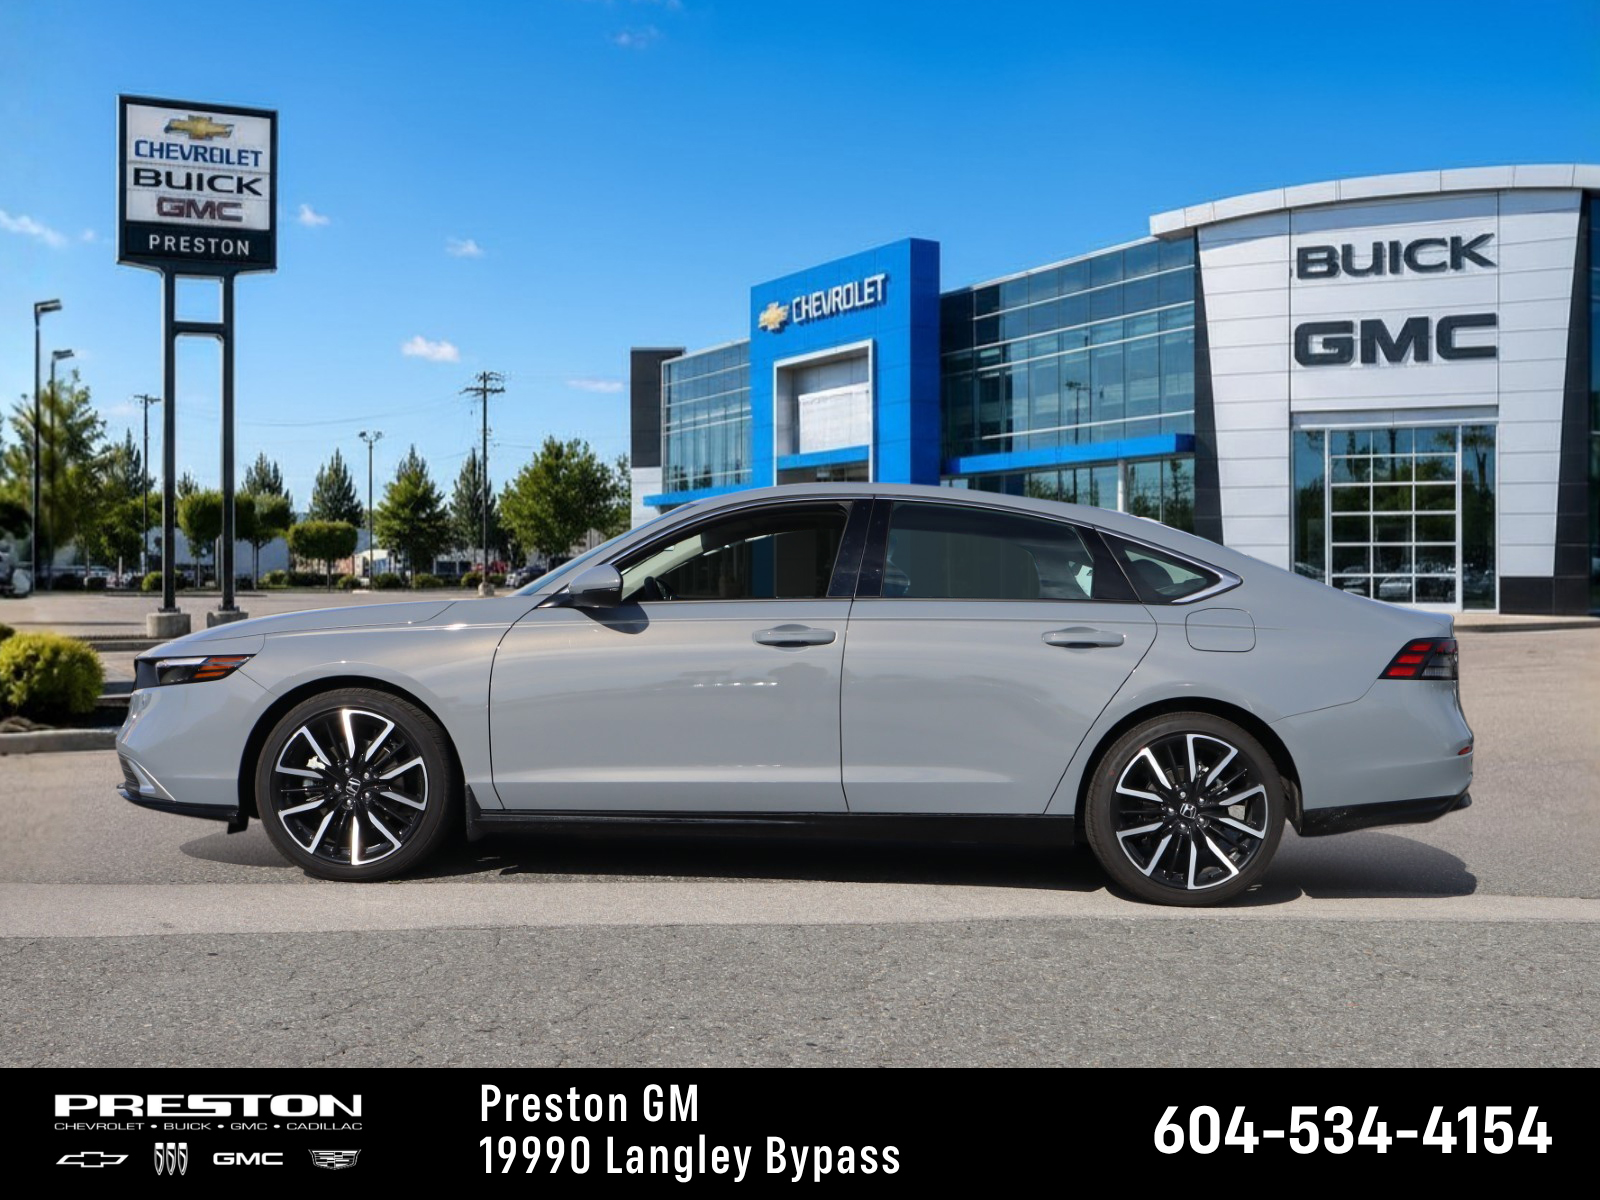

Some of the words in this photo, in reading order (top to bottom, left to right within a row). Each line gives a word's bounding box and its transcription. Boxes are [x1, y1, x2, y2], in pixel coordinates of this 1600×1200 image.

[134, 139, 263, 167] CHEVROLET
[133, 167, 263, 197] BUICK
[156, 196, 243, 223] GMC
[149, 234, 250, 256] PRESTON
[1297, 232, 1498, 280] BUICK
[792, 273, 886, 324] CHEVROLET
[1294, 312, 1498, 367] GMC
